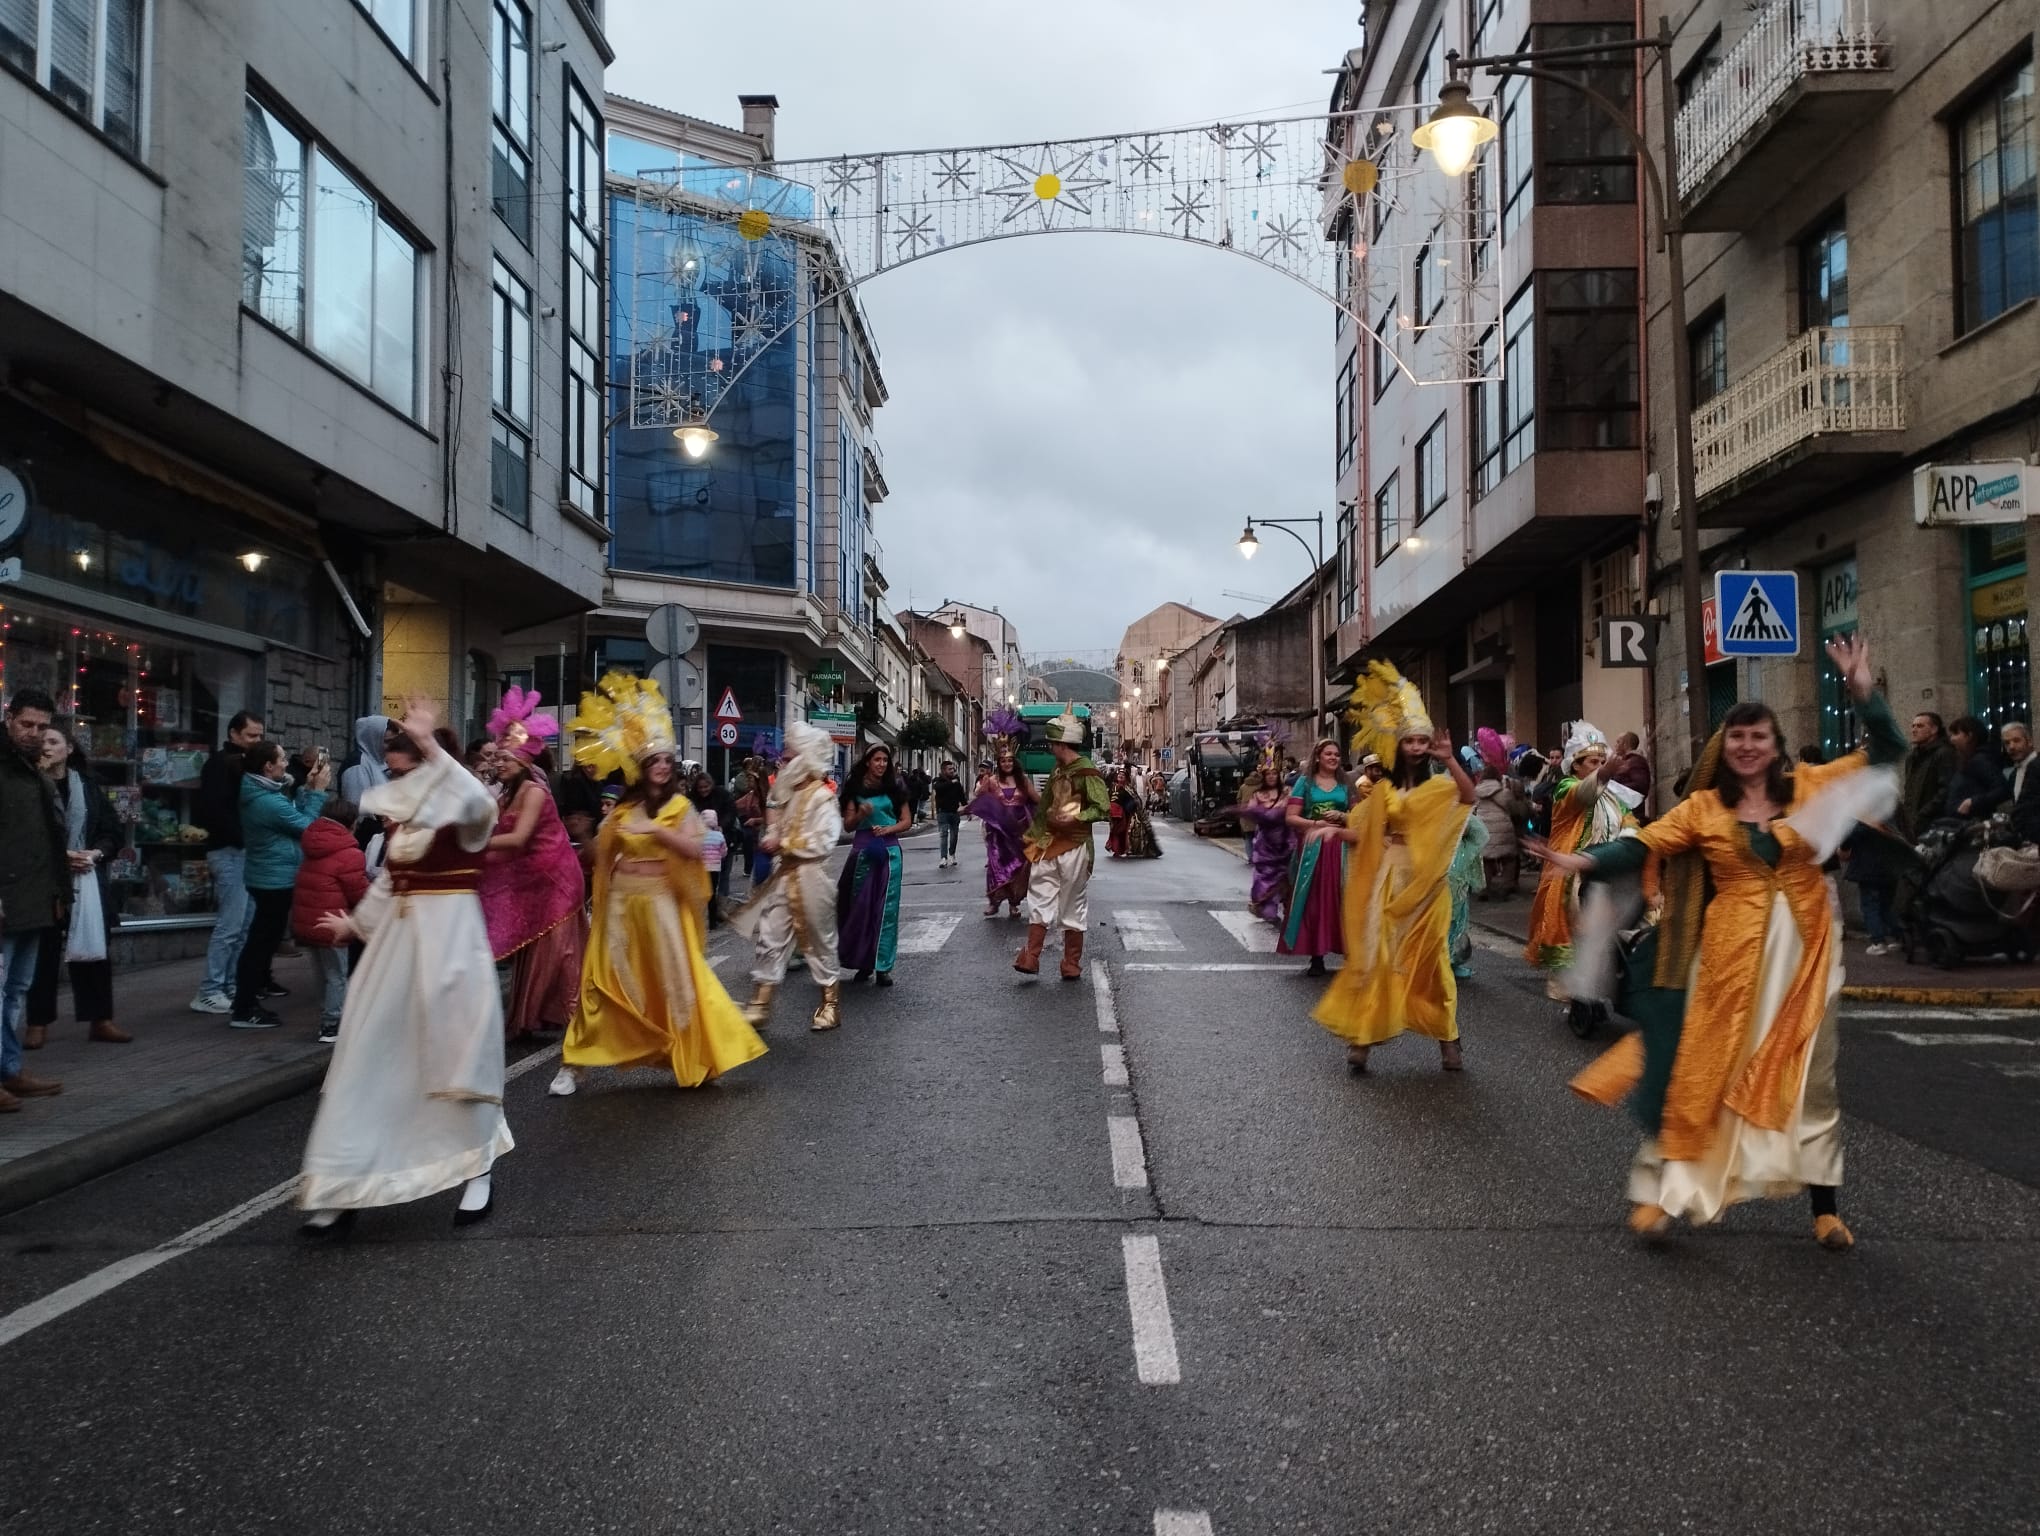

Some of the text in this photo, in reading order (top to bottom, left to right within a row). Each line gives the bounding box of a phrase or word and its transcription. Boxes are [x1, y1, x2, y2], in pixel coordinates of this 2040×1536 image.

[1932, 475, 1978, 512] APP
[1824, 572, 1852, 616] APP
[1609, 621, 1648, 661] R
[811, 673, 842, 681] FARMACIA
[722, 729, 736, 739] 30
